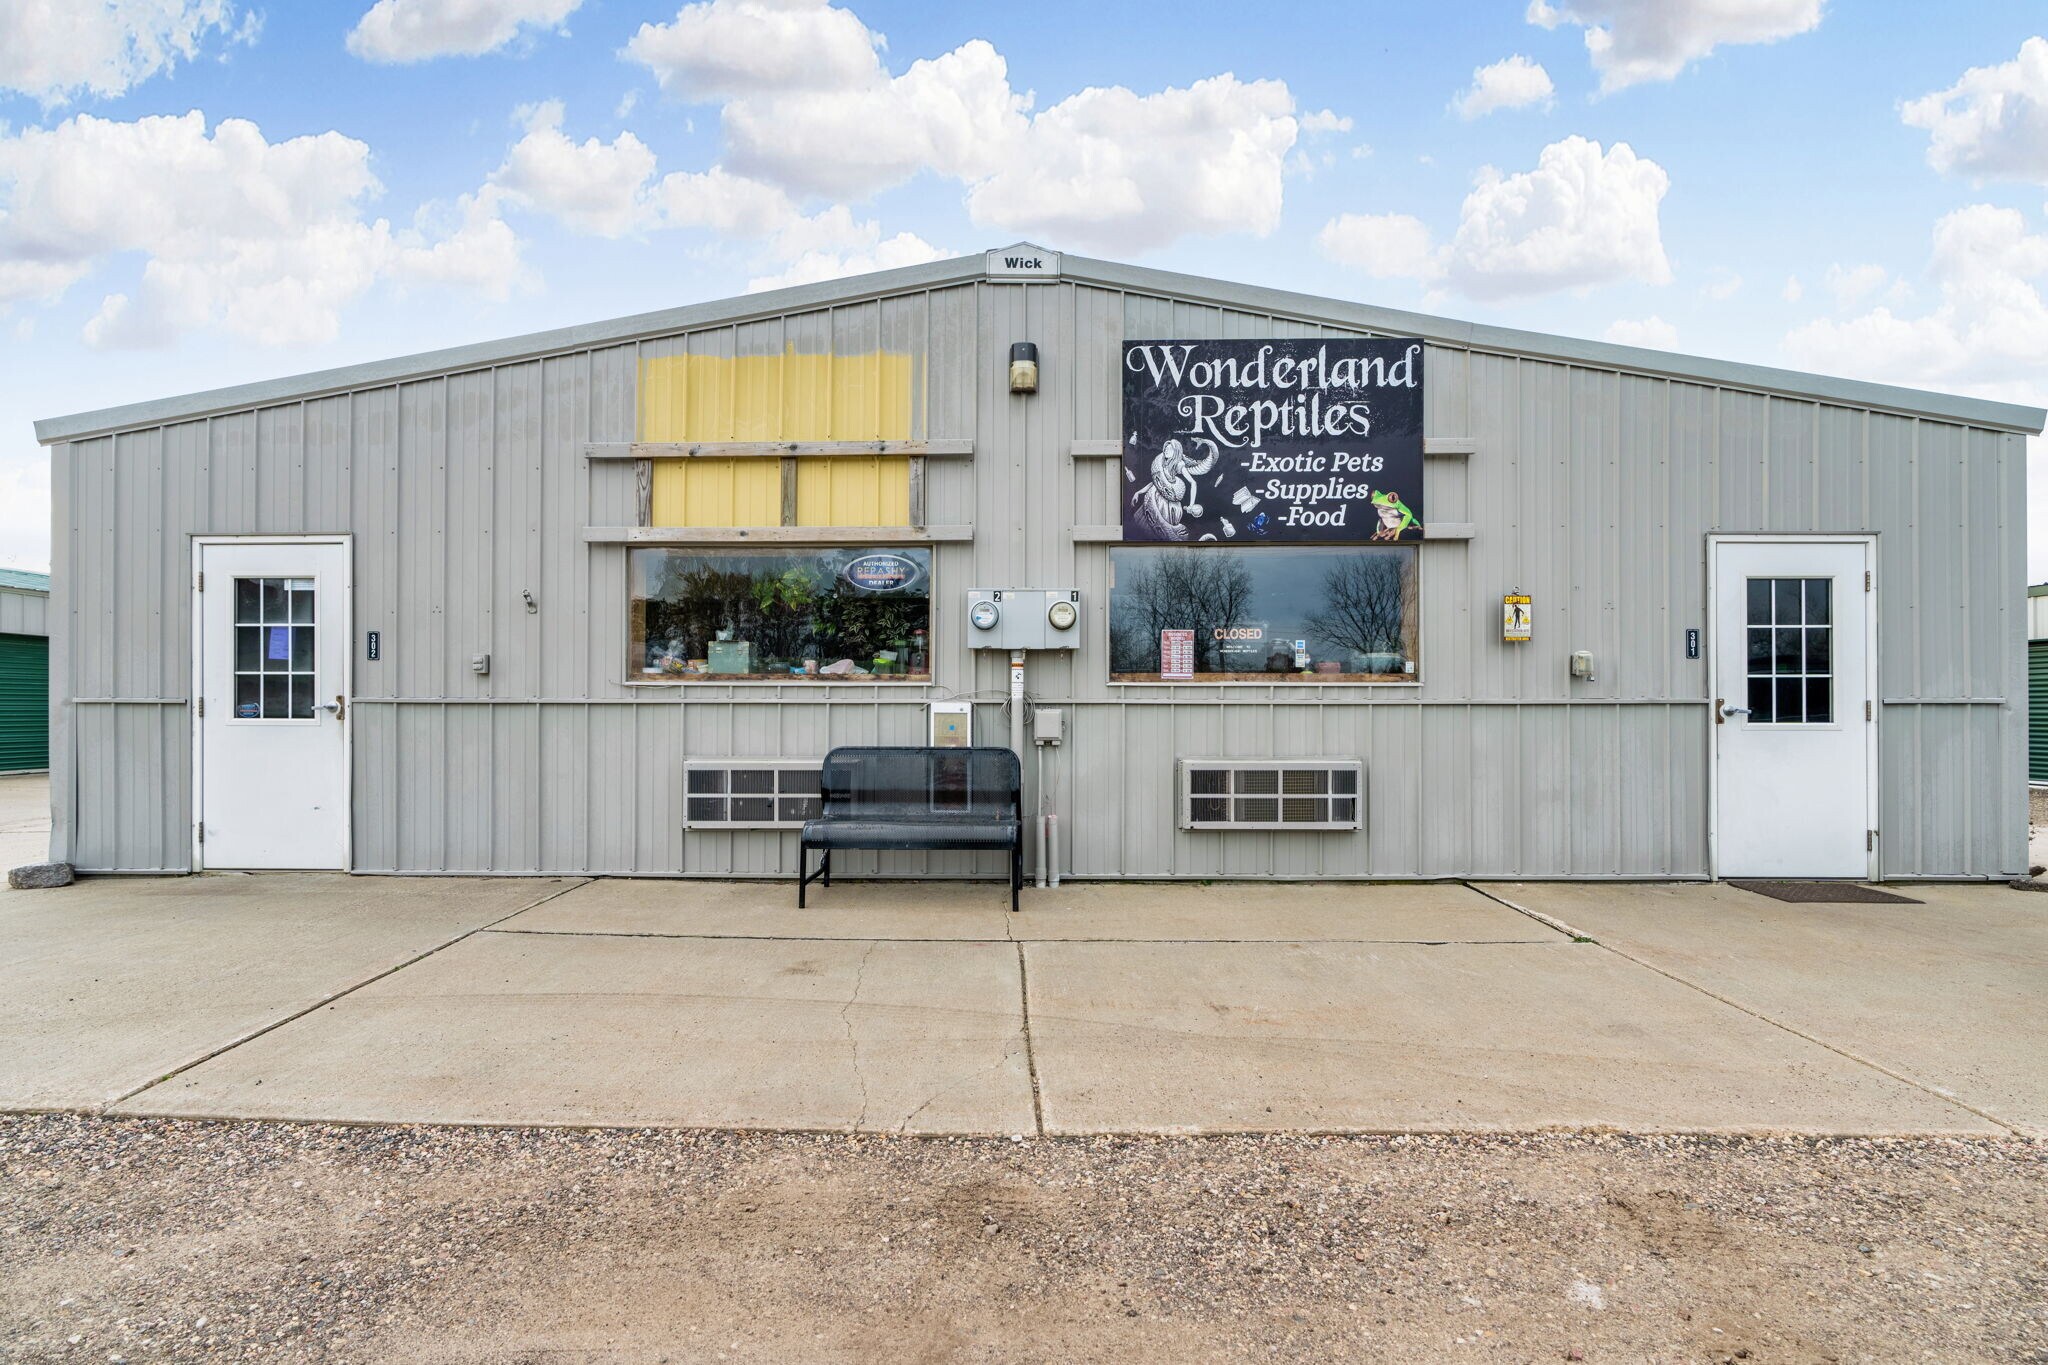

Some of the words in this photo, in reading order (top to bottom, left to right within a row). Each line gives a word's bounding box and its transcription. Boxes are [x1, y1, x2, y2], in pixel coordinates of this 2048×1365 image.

[1004, 257, 1042, 269] Wick
[1126, 344, 1420, 388] Wonderland
[1178, 394, 1370, 448] Reptiles
[1240, 450, 1326, 473] -Exotic
[1331, 451, 1384, 473] Pets
[1255, 477, 1369, 505] -Supplies
[1277, 504, 1347, 527] -Food
[994, 591, 1001, 601] 2
[1071, 591, 1078, 601] 1
[1214, 628, 1263, 640] CLOSED
